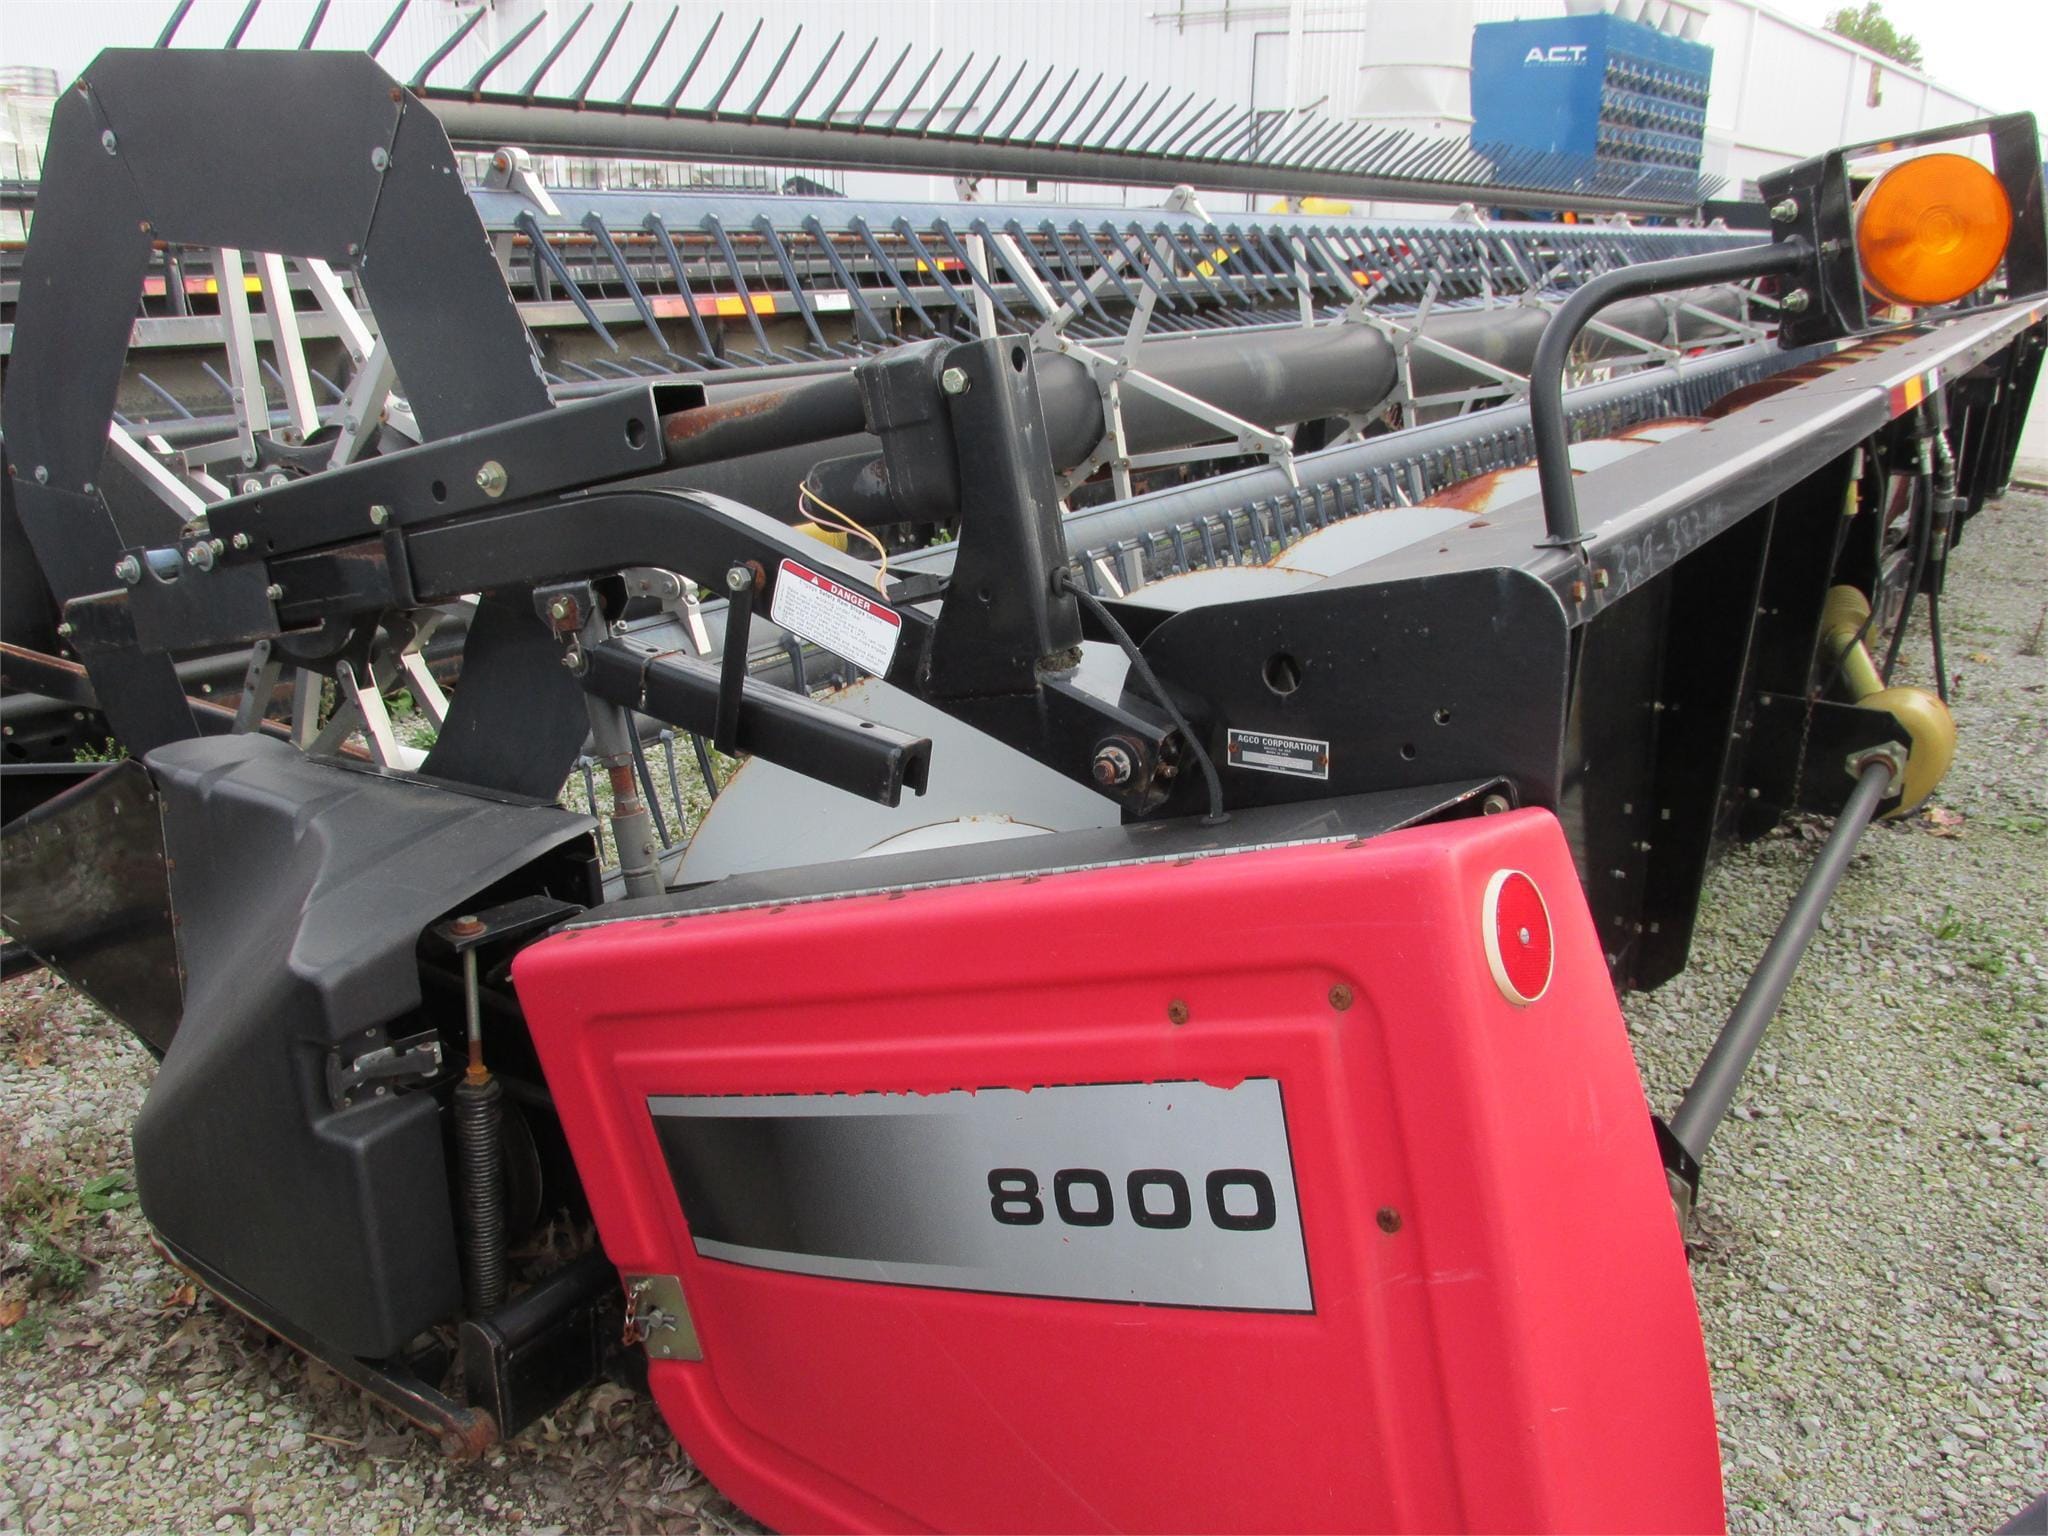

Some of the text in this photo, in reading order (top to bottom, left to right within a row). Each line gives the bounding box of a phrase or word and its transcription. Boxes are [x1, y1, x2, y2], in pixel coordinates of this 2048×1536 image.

[1524, 45, 1588, 63] A.C.T.
[830, 585, 871, 611] DANGER
[1238, 734, 1260, 744] AGCO
[1262, 737, 1320, 753] CORPORATION
[987, 1168, 1276, 1231] 8000
